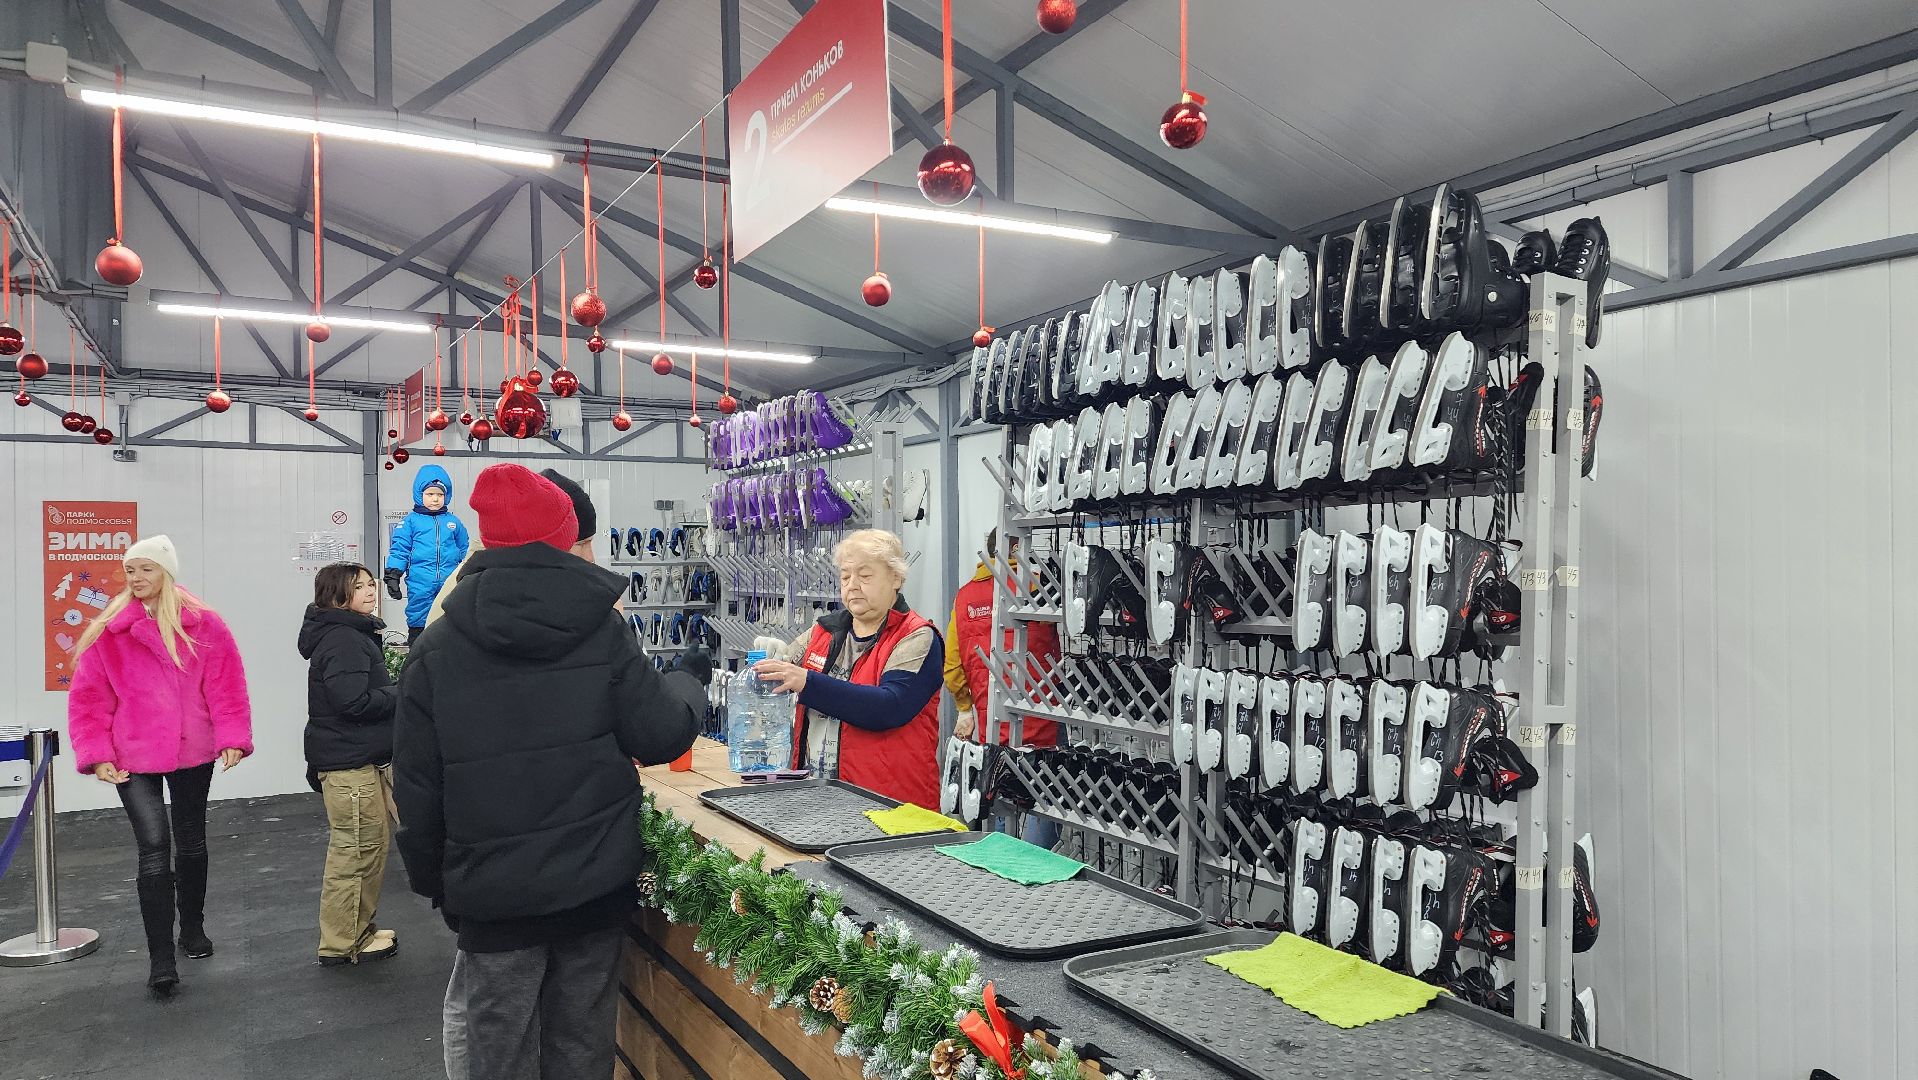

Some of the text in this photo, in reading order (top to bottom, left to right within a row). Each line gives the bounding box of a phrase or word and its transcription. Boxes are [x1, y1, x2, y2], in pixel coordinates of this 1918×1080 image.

[800, 39, 844, 93] КОНЬКОВ
[771, 112, 796, 143] skates
[744, 110, 771, 212] 2
[1447, 406, 1460, 422] 44
[48, 532, 132, 551] ЗИМА
[58, 554, 126, 562] ПОДМОСКОВЬ
[1388, 574, 1400, 590] 43
[1430, 576, 1445, 591] 43
[1522, 572, 1534, 586] 43
[1276, 716, 1286, 729] 42
[1310, 720, 1320, 734] 42
[1344, 724, 1355, 737] 42
[1387, 727, 1399, 743] 42
[1430, 732, 1441, 749] 42
[1520, 727, 1544, 744] 42 42
[1564, 726, 1576, 740] 37
[1314, 734, 1326, 750] 12
[1392, 743, 1402, 756] 13
[1434, 750, 1444, 762] 13
[1519, 868, 1529, 883] 41
[1428, 892, 1440, 909] 41
